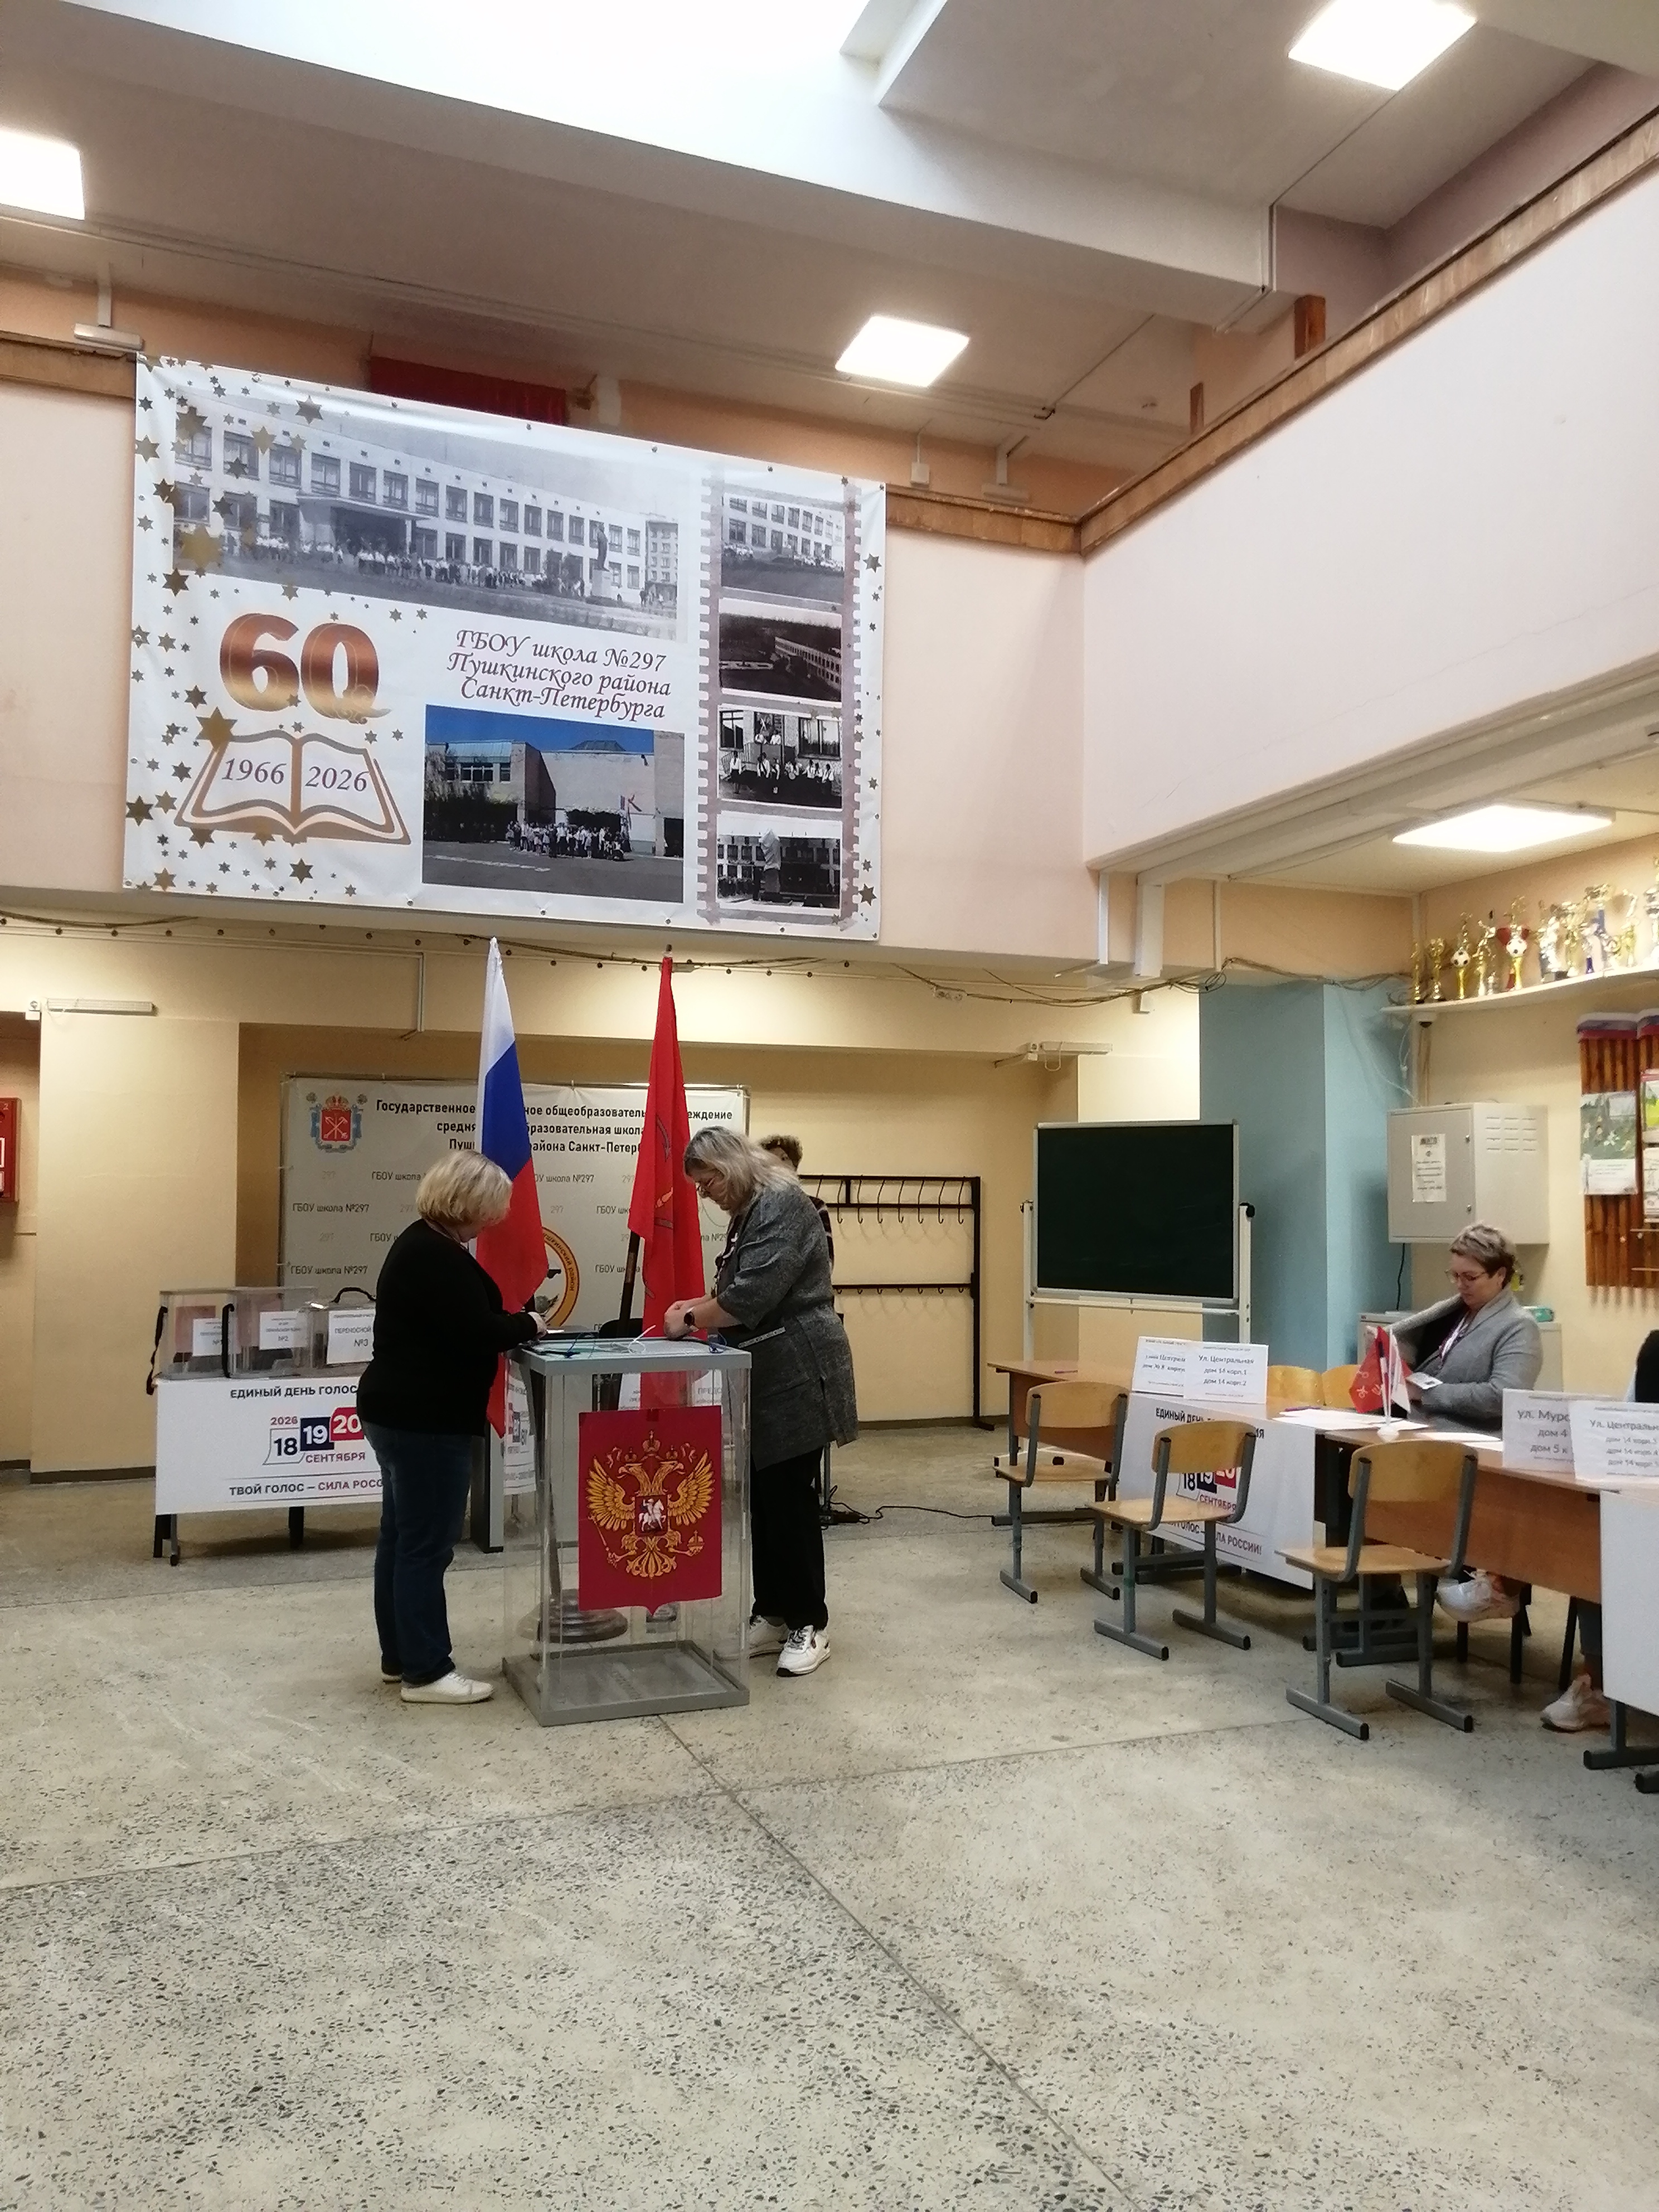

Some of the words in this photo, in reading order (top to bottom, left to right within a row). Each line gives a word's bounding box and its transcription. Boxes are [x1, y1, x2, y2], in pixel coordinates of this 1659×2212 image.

[456, 629, 531, 657] ГБОУ
[532, 642, 598, 665] школа
[603, 648, 667, 672] №297
[220, 613, 387, 723] 60
[447, 652, 593, 687] Пушкинского
[599, 674, 671, 696] района
[460, 676, 665, 721] Санкт-Петербурга
[221, 758, 287, 785] 1966
[305, 766, 370, 792] 2026
[376, 1099, 476, 1115] Государственное
[546, 1105, 646, 1118] общеобразователь
[688, 1112, 733, 1120] еждение
[614, 1127, 643, 1135] школ
[532, 1139, 565, 1152] айона
[569, 1141, 641, 1155] Санкт-Петер
[372, 1171, 393, 1181] ГБОУ
[573, 1174, 595, 1183] №297
[292, 1203, 314, 1212] ГБОУ
[346, 1203, 370, 1212] №297
[596, 1205, 617, 1214] ГБОУ
[370, 1233, 391, 1241] ГБОУ
[291, 1265, 312, 1274] ГБОУ
[344, 1265, 368, 1275] №297
[595, 1264, 615, 1273] ГБОУ
[230, 1386, 282, 1399] ЕДИНЫЙ
[284, 1386, 316, 1398] ДЕНЬ
[319, 1385, 358, 1395] ГОЛОС
[270, 1417, 298, 1425] 2026
[1156, 1407, 1185, 1422] ЕДИНЫЙ
[1539, 1410, 1570, 1423] Мурс
[274, 1437, 298, 1456] 18
[303, 1425, 328, 1444] 19
[333, 1414, 362, 1434] 20
[305, 1452, 366, 1463] СЕНТЯБРЯ
[230, 1483, 261, 1496] ТВОЙ
[265, 1483, 304, 1494] ГОЛОС
[318, 1481, 350, 1491] СИЛА
[353, 1479, 383, 1488] РОСС
[1228, 1536, 1262, 1555] РОССИИ!
